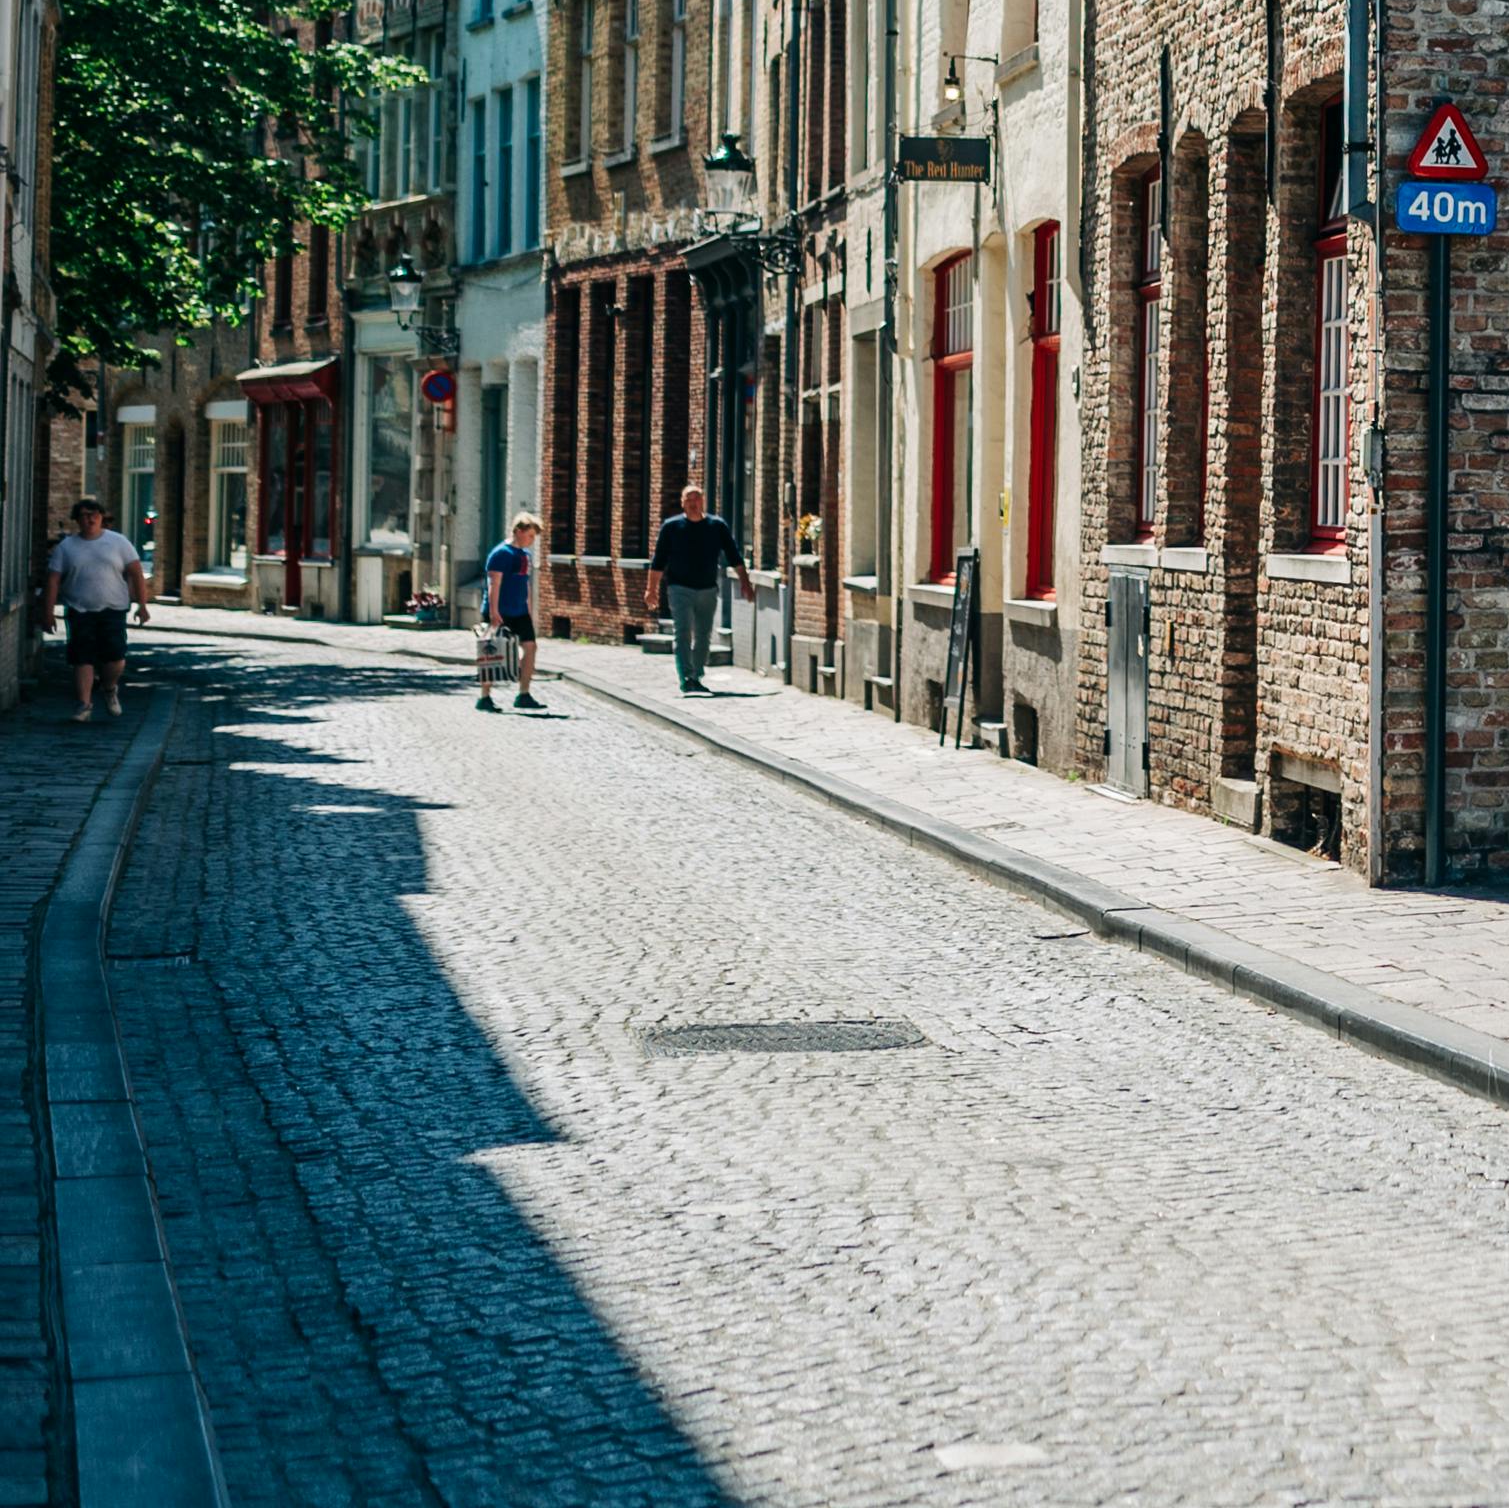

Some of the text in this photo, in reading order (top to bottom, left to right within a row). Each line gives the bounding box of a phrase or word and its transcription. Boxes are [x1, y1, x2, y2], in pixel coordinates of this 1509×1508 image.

[904, 160, 984, 179] The Red Hunter
[1408, 190, 1487, 224] 40m
